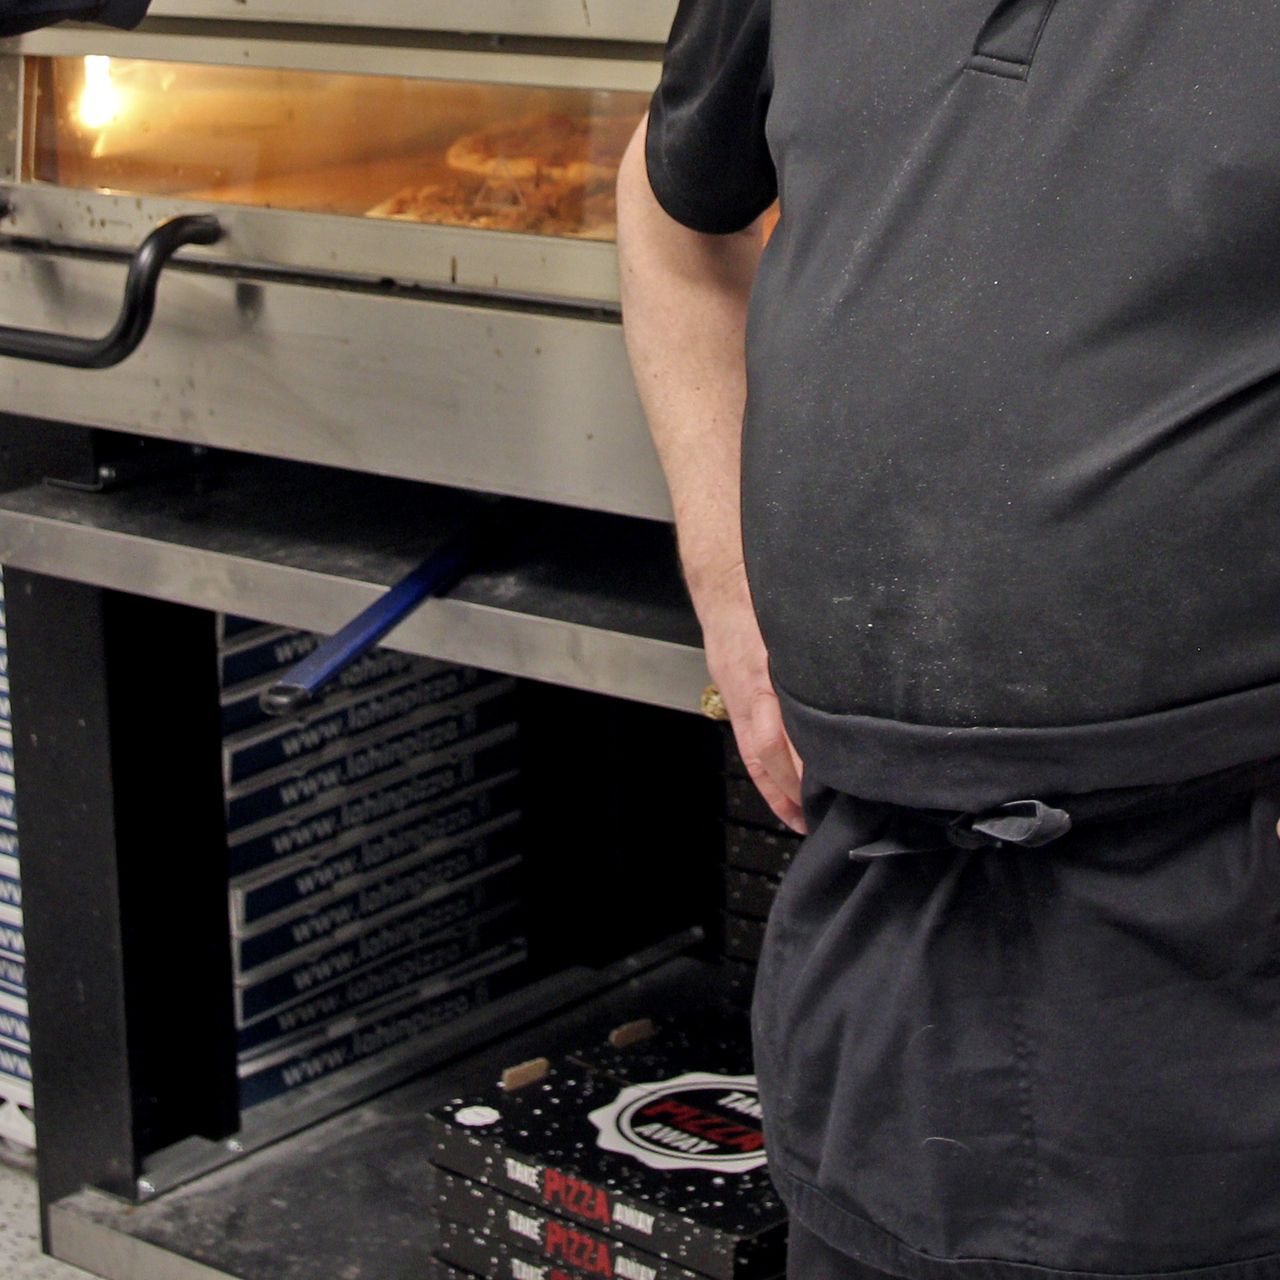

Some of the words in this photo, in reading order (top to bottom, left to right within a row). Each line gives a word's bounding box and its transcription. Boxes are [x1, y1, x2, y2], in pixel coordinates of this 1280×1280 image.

[641, 1100, 765, 1152] PIZZA
[717, 1091, 764, 1119] TAK
[633, 1122, 719, 1154] AWAY
[544, 1168, 611, 1226] PIZZA
[546, 1221, 613, 1279] PIZZA
